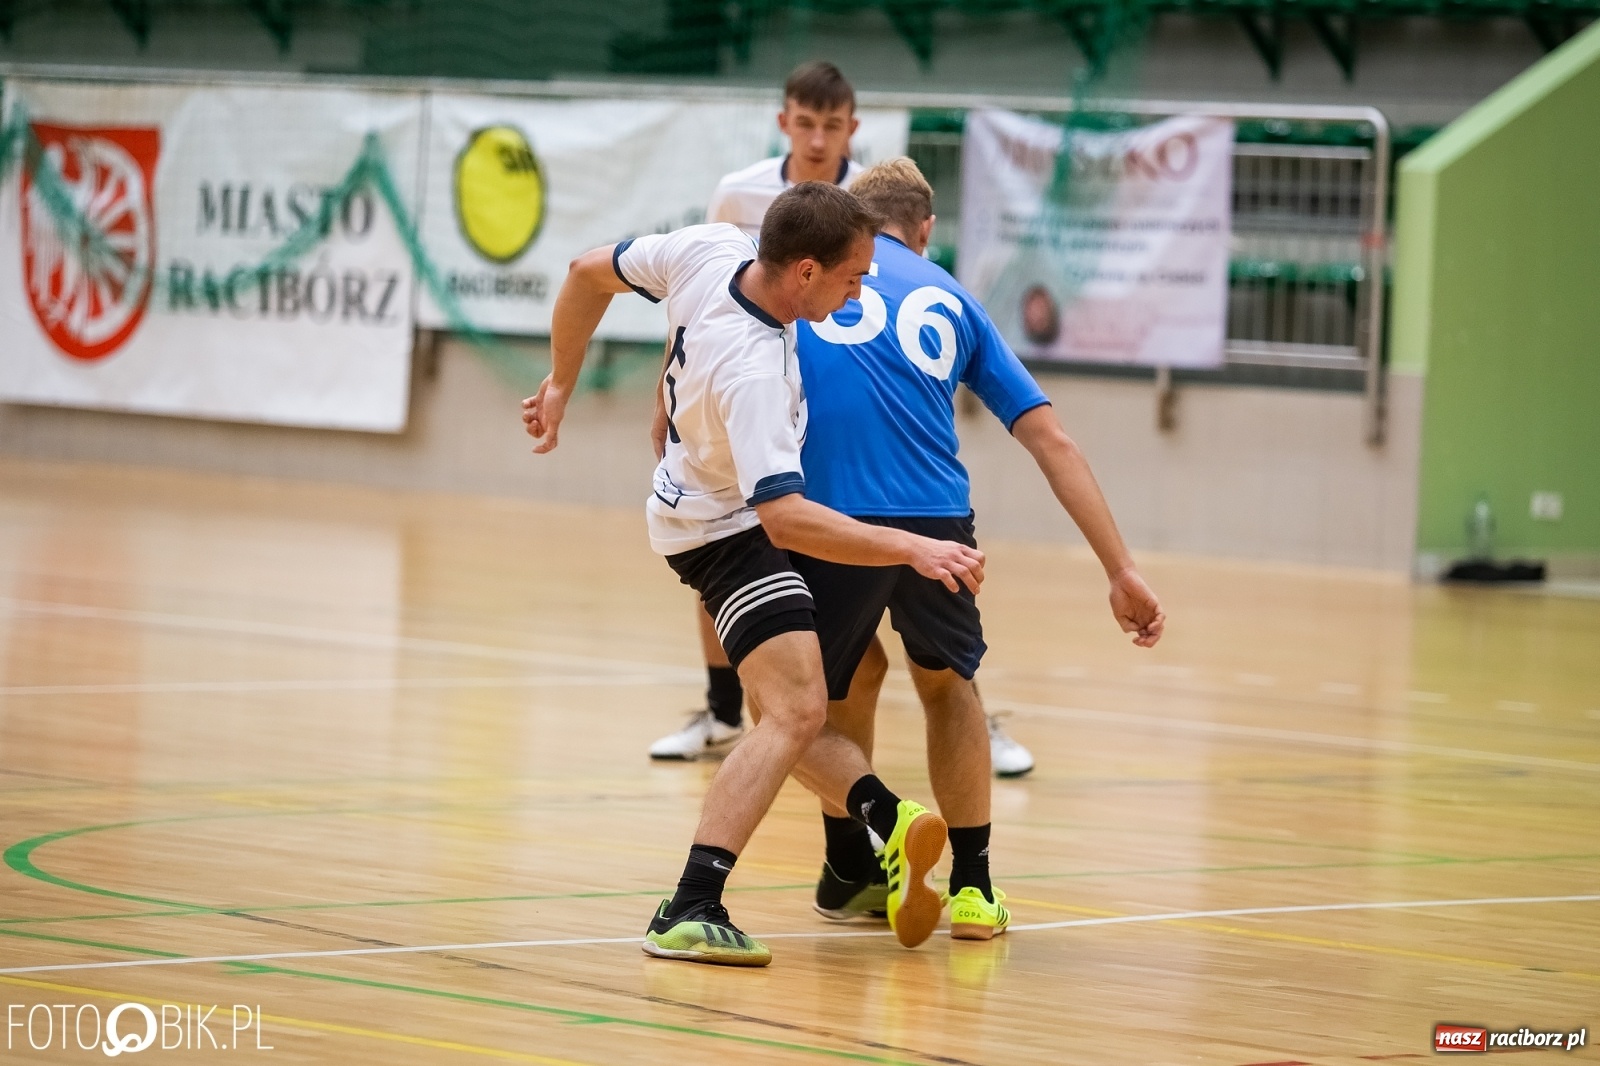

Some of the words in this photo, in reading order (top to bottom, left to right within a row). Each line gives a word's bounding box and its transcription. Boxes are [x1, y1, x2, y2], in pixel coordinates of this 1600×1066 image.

[198, 180, 374, 244] MIASTO
[168, 253, 400, 326] RACIBÓRZ
[958, 910, 982, 919] COPA
